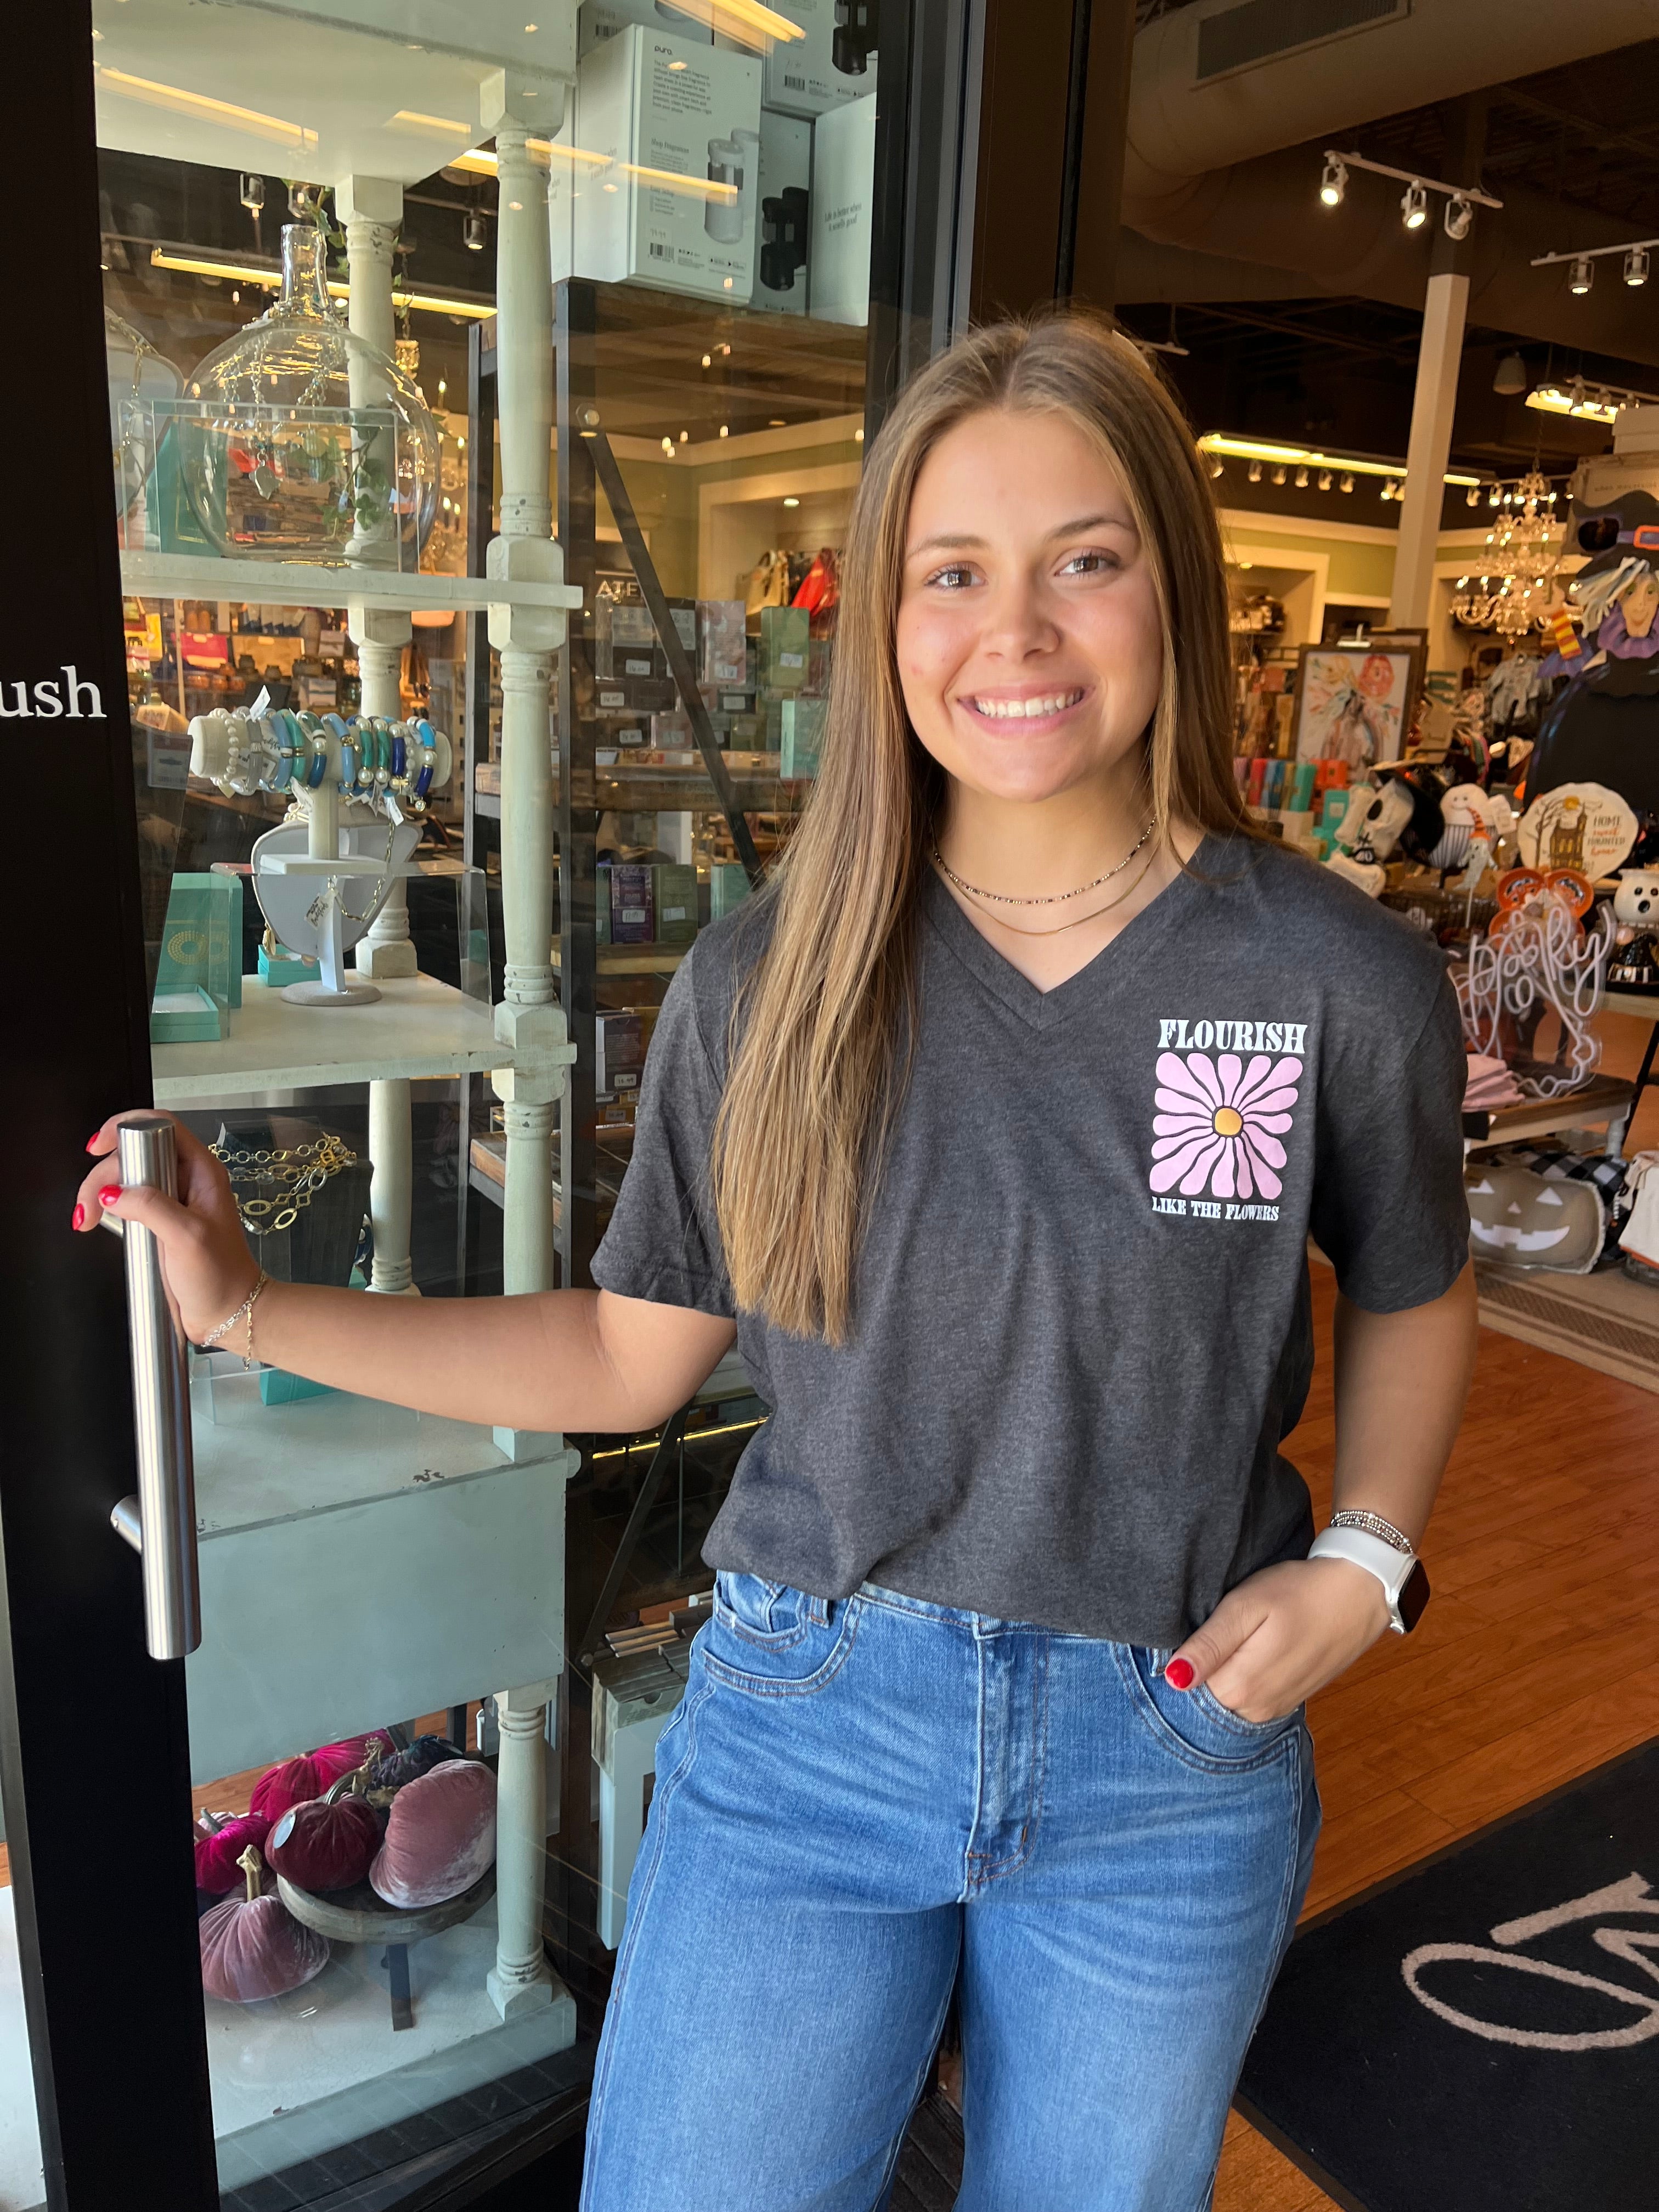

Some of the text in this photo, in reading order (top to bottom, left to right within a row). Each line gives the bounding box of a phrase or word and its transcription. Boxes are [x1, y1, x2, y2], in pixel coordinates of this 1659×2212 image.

[1157, 1019, 1308, 1053] FLOURISH
[1152, 1196, 1280, 1221] LIKE THE FLOWERS
